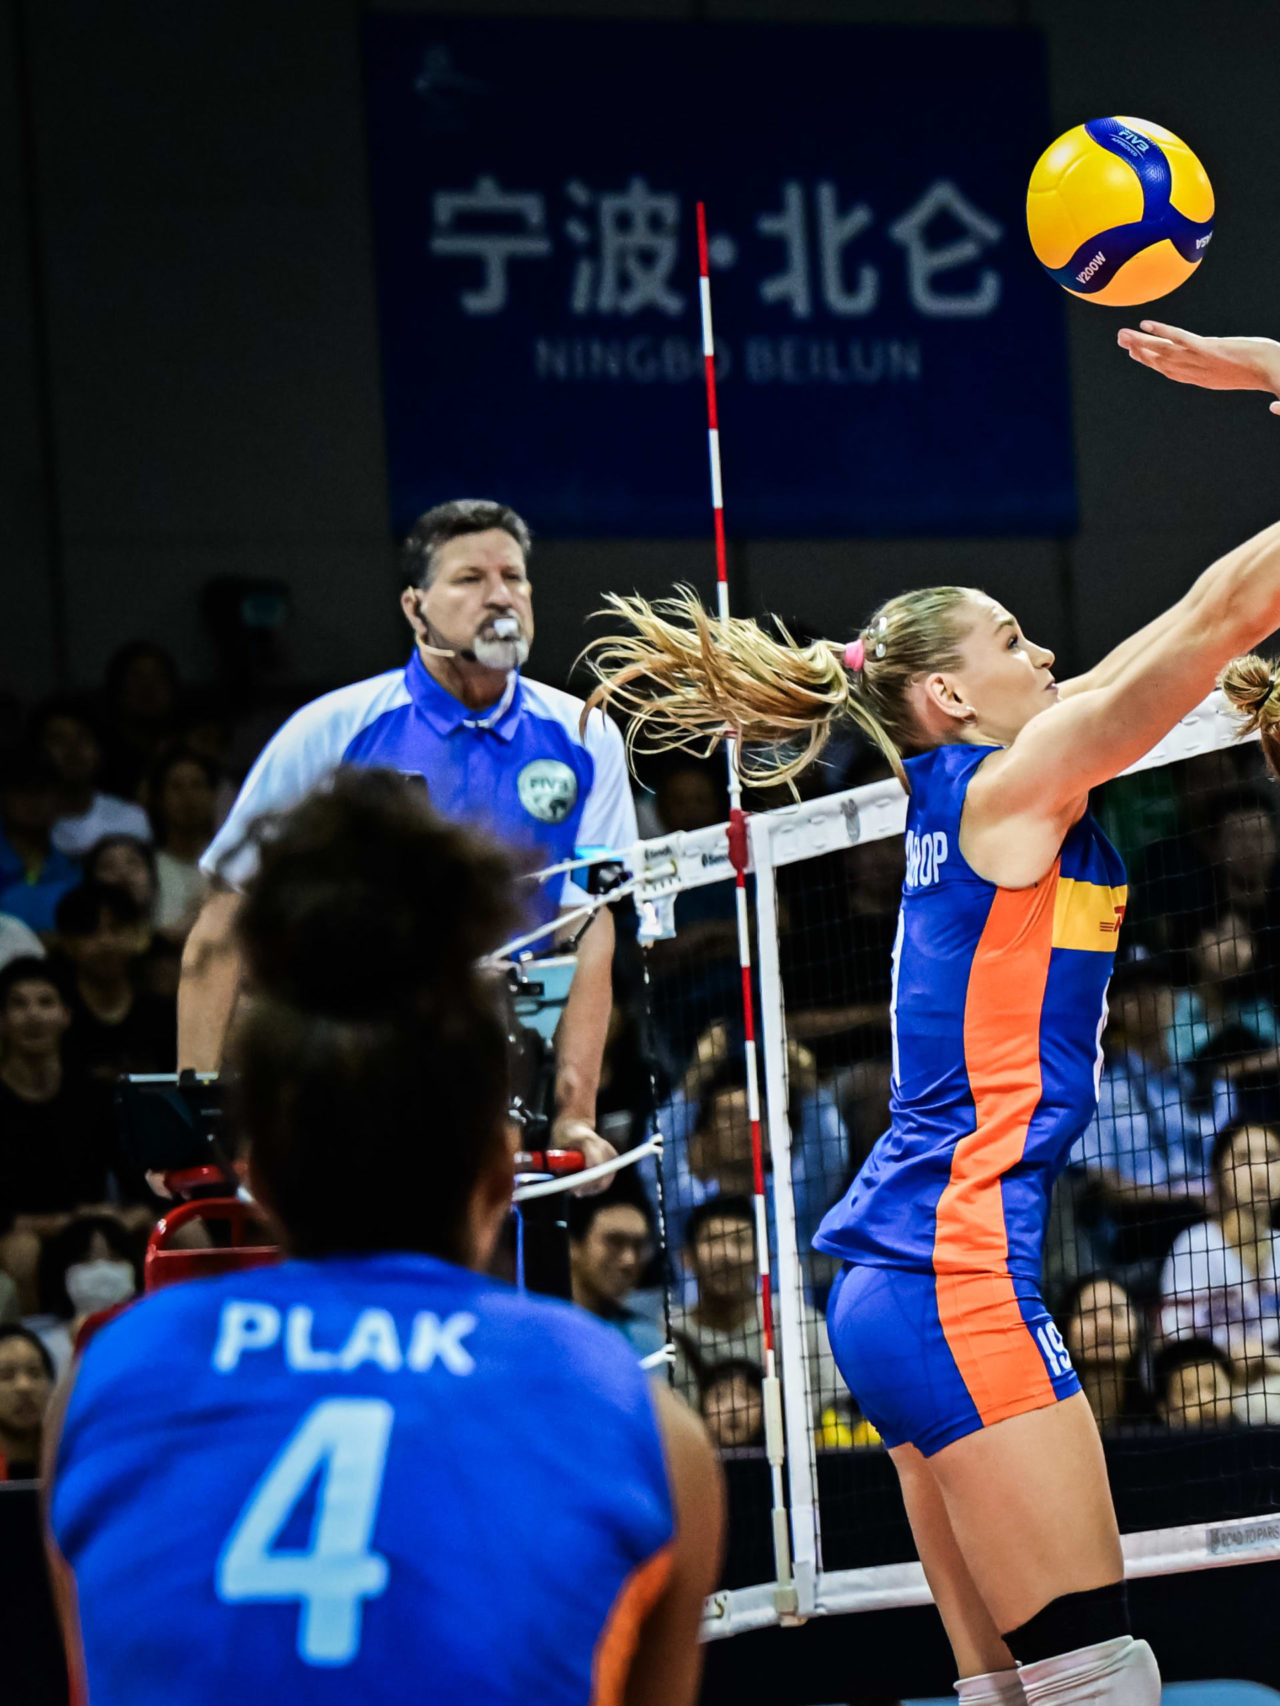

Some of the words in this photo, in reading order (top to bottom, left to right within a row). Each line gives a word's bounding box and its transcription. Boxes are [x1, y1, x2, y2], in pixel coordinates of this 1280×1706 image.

[1075, 250, 1106, 284] V200W
[535, 335, 732, 384] NINGBO
[744, 335, 922, 384] BEILUN
[211, 1298, 478, 1377] PLAK
[1036, 1320, 1073, 1377] 19
[215, 1395, 396, 1668] 4
